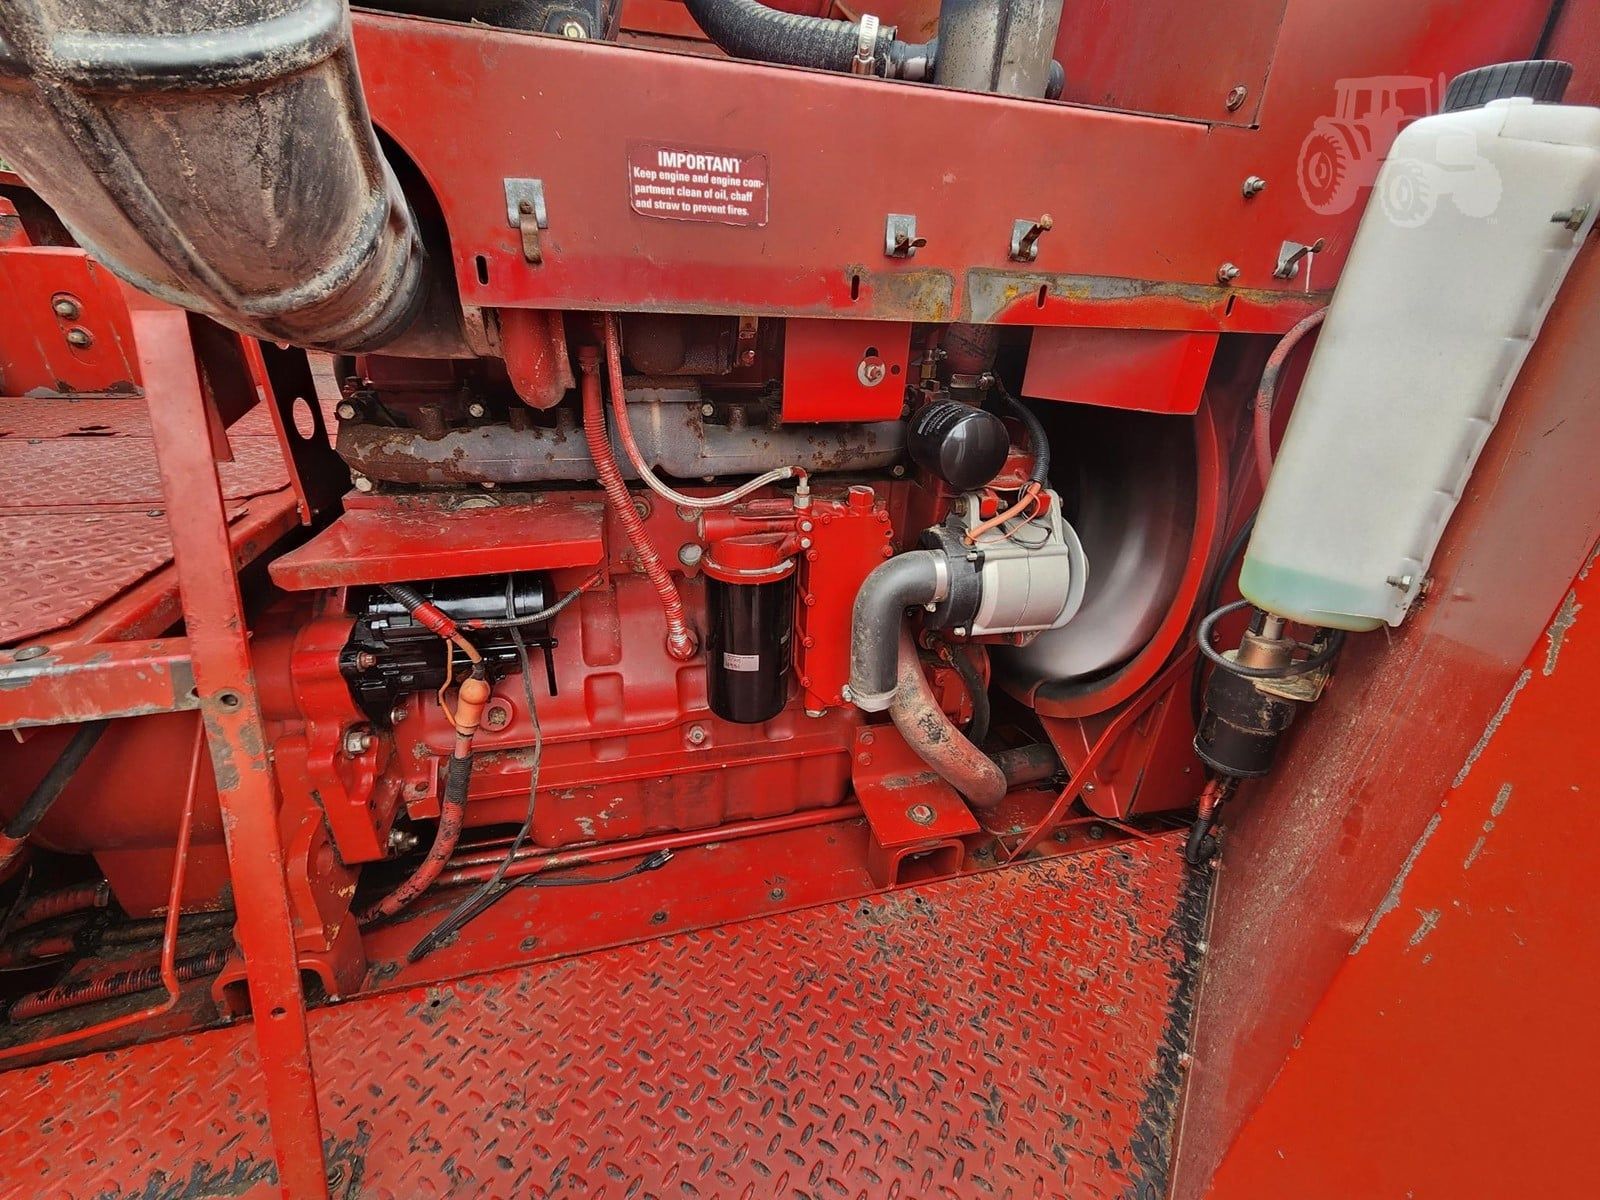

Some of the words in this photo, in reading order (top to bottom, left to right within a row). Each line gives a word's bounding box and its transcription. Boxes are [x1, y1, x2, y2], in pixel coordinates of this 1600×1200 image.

[658, 151, 741, 173] IMPORTANT
[633, 166, 656, 180] Keep
[659, 171, 690, 183] engine
[692, 173, 709, 184] and
[711, 175, 741, 187] engine
[743, 179, 764, 188] com-
[635, 184, 675, 195] partment
[677, 186, 702, 198] clean
[704, 189, 713, 199] of
[715, 190, 729, 201] oil,
[731, 190, 753, 202] chaff
[635, 198, 652, 208] and
[654, 201, 680, 210] straw
[682, 202, 691, 211] to
[693, 204, 726, 215] prevent
[728, 204, 750, 216] fires.
